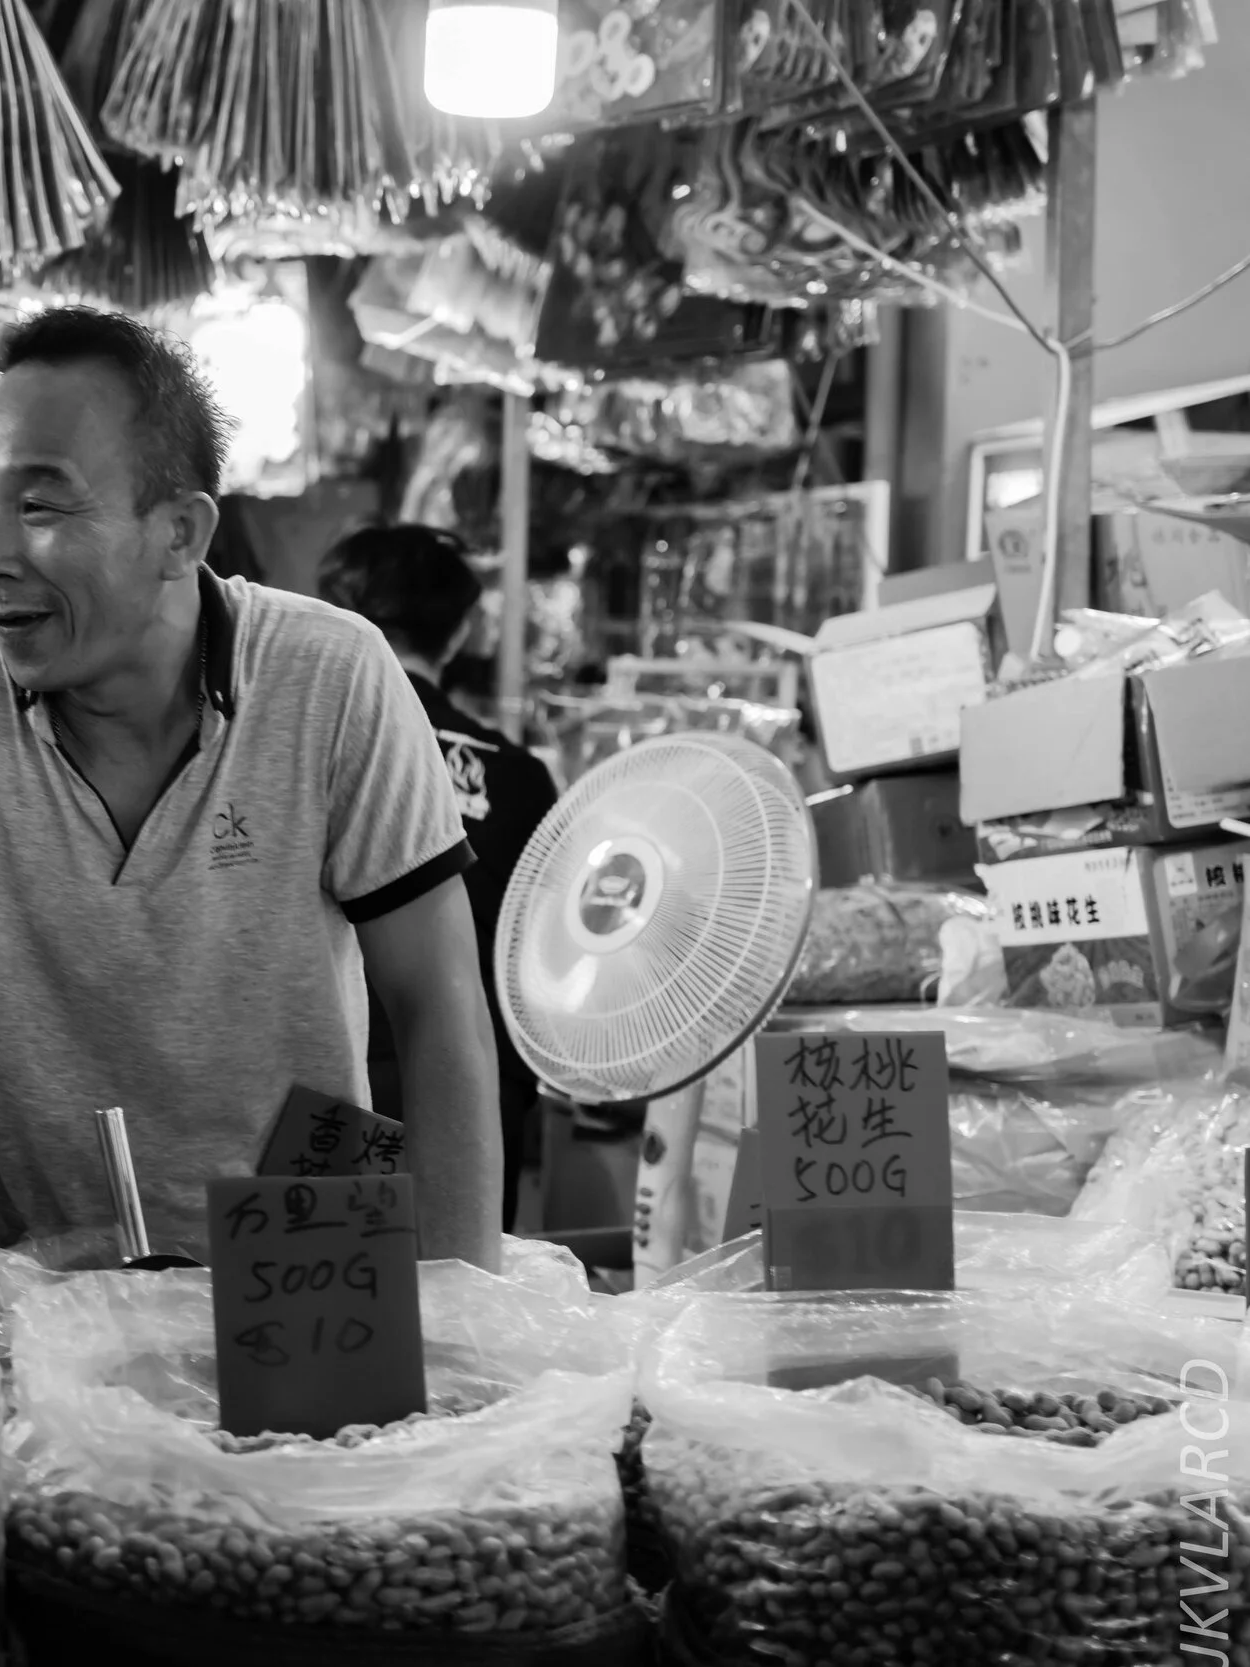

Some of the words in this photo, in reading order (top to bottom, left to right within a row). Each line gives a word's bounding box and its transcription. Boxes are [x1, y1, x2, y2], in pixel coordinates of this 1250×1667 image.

[213, 803, 249, 839] ck
[784, 1036, 920, 1092] 核桃
[787, 1094, 914, 1149] 花生
[794, 1154, 907, 1202] 500G
[244, 1252, 378, 1302] 500G
